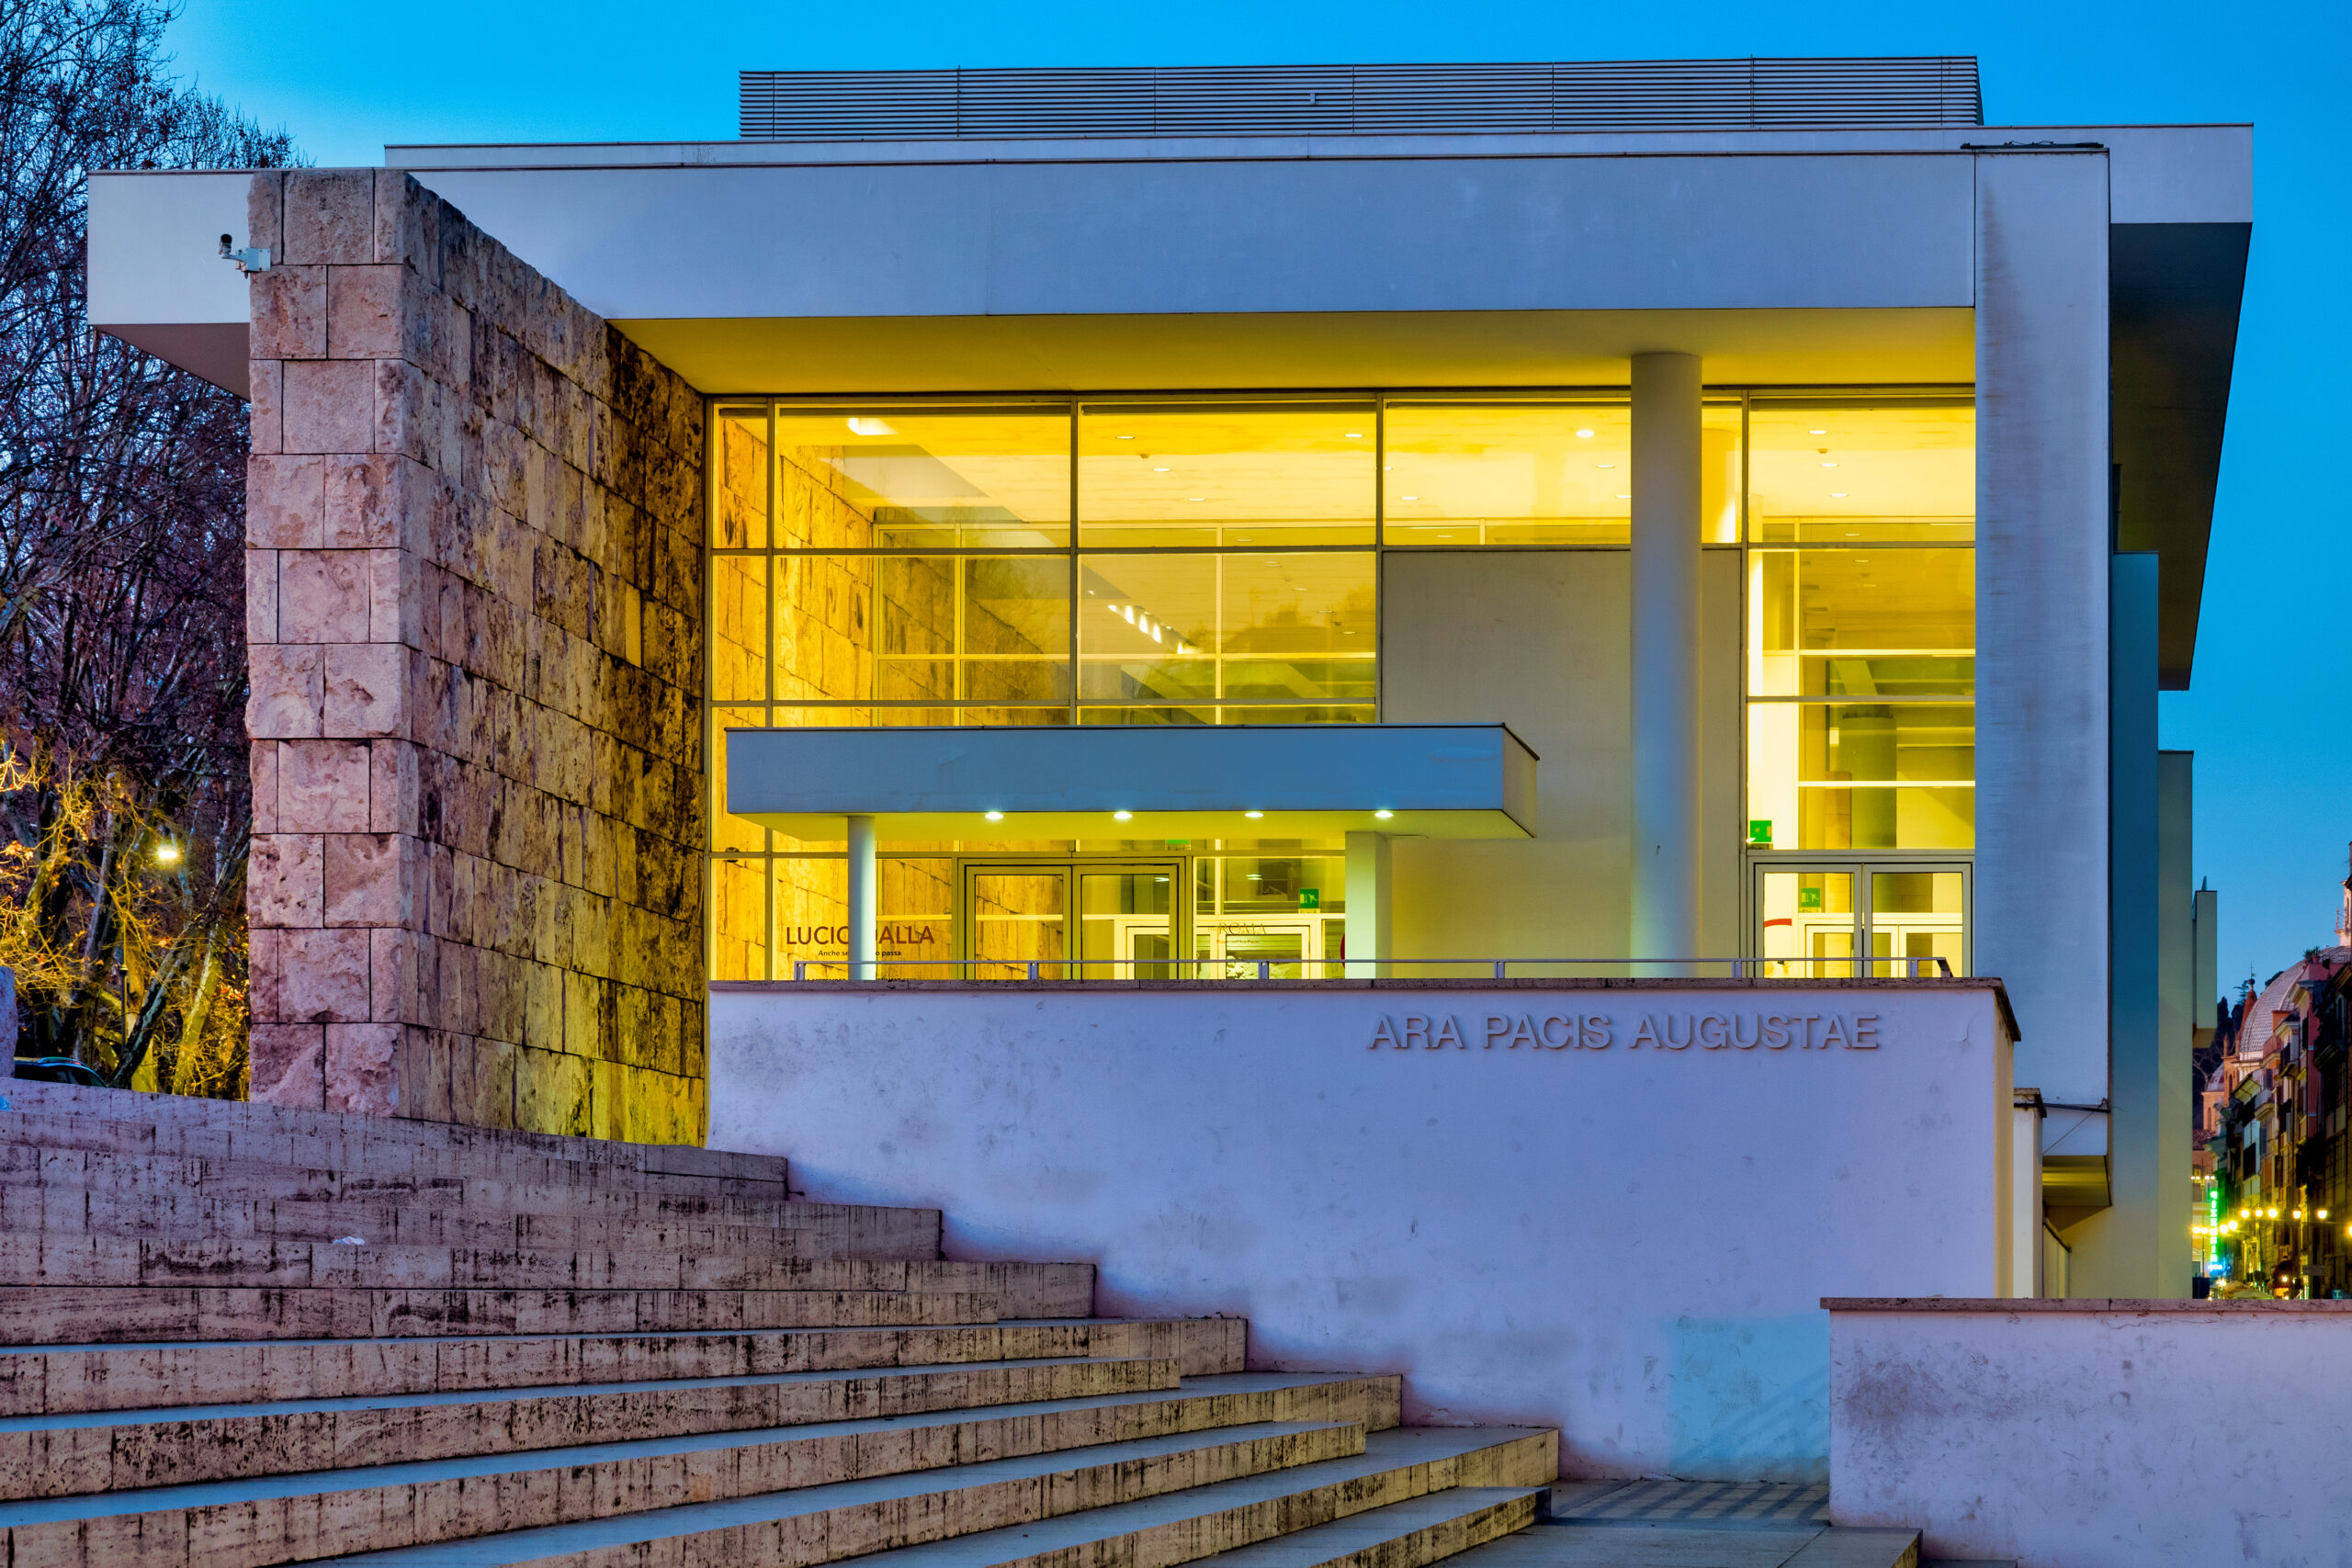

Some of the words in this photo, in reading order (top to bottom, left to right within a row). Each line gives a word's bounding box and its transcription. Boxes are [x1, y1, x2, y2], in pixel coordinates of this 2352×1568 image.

[876, 926, 934, 944] ALLA
[1366, 1013, 1464, 1049] ARA
[1483, 1013, 1611, 1050] PACIS
[1628, 1013, 1880, 1050] AUGUSTAE
